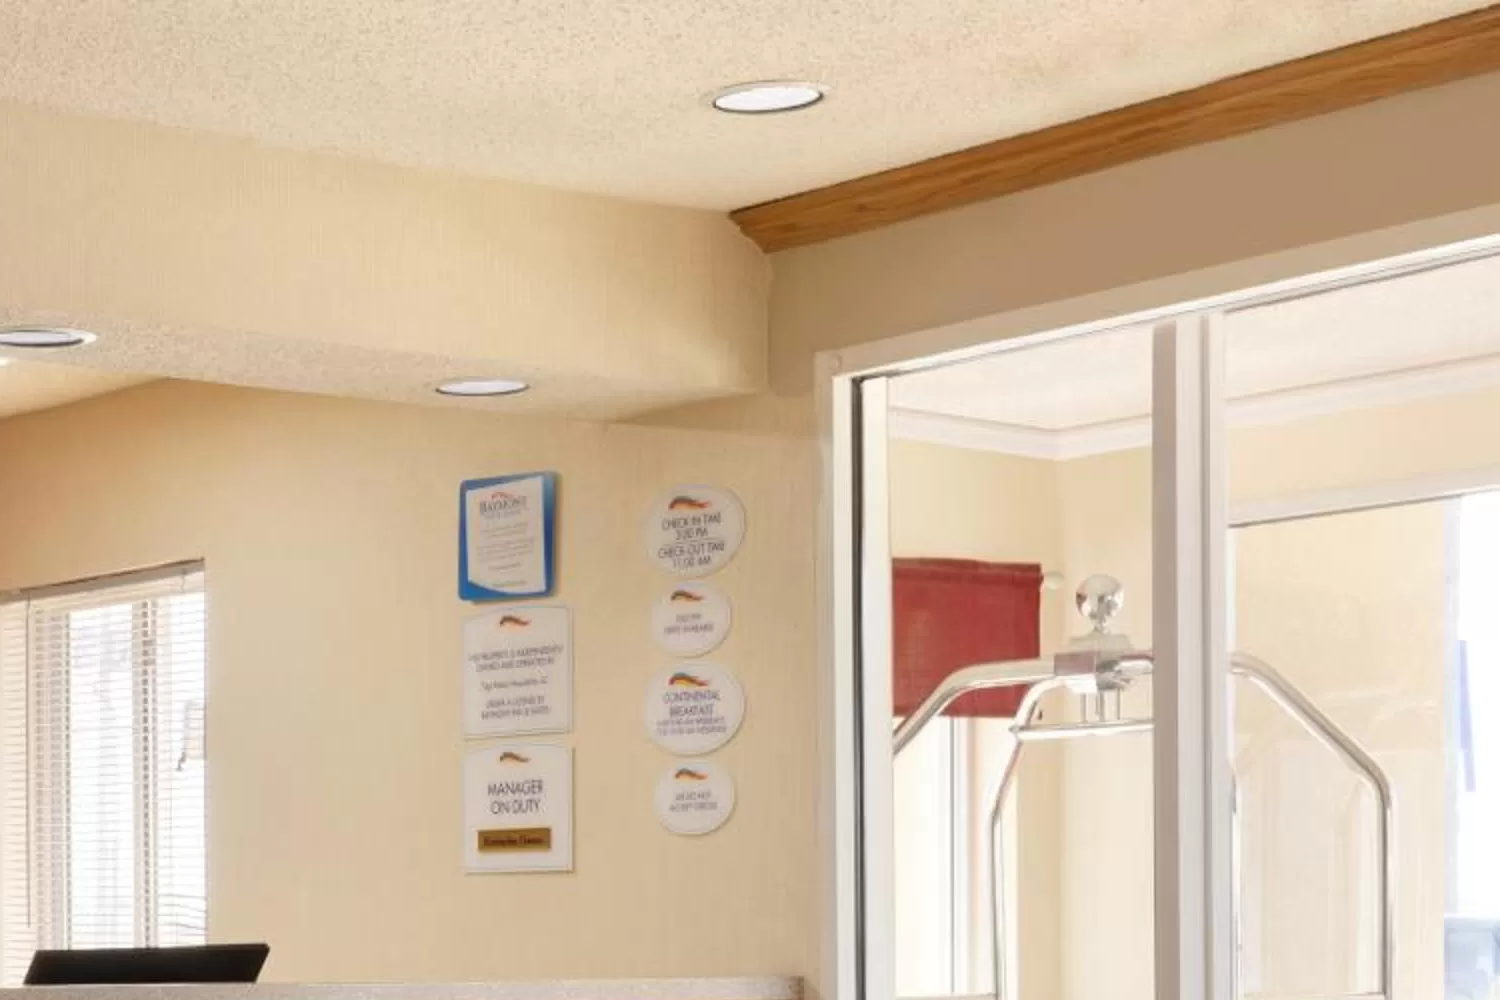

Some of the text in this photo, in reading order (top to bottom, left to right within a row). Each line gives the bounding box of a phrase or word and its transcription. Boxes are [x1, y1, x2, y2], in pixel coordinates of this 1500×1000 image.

[687, 543, 705, 556] OUT
[487, 779, 543, 797] MANAGER
[490, 798, 541, 815] ON DUTY
